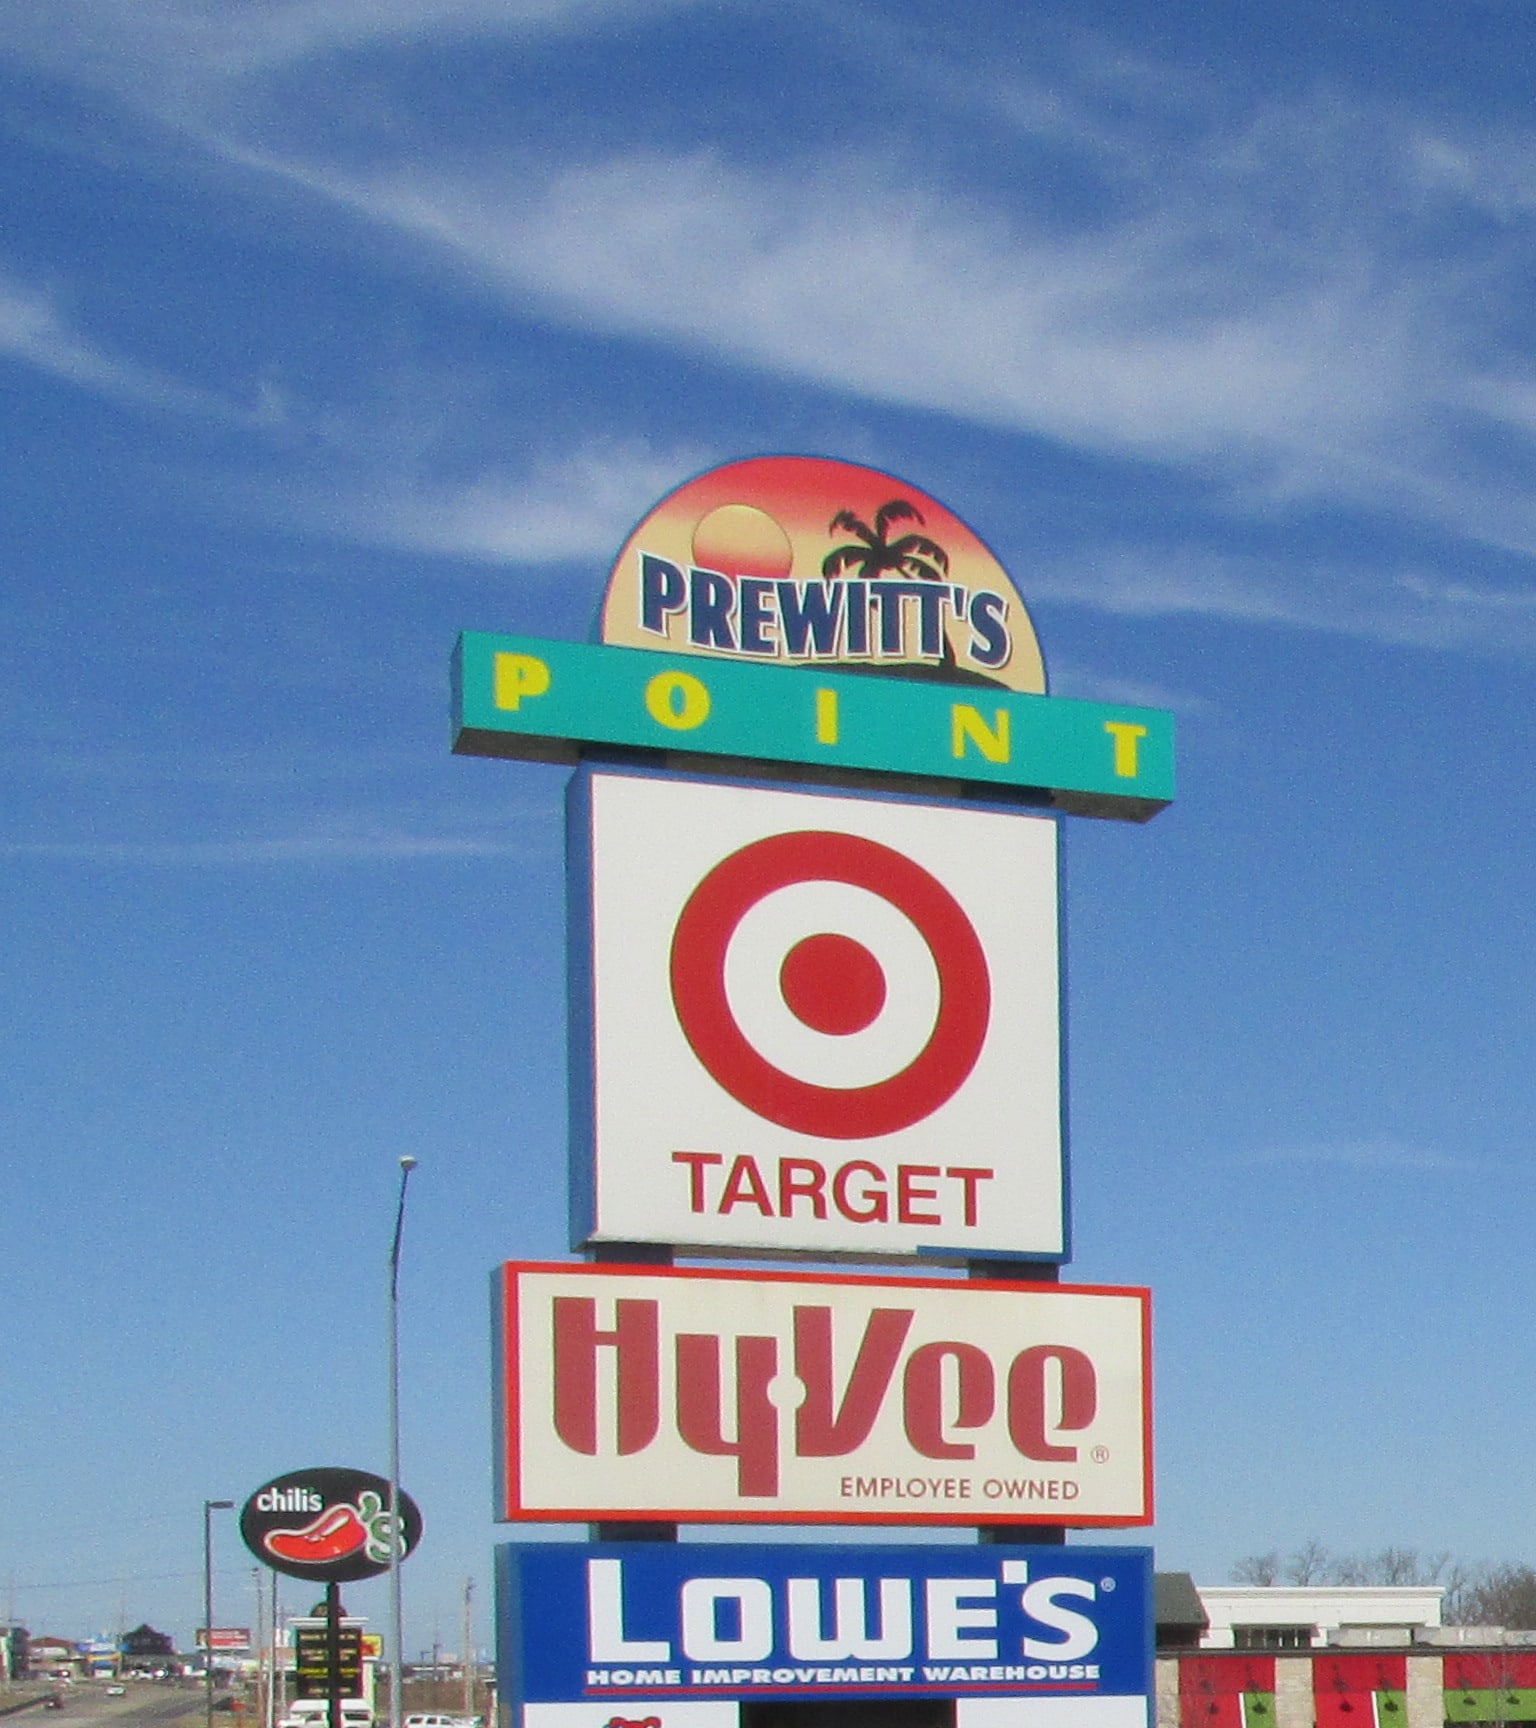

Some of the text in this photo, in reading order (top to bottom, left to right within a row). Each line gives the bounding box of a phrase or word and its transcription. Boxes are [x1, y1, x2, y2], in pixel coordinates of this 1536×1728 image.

[638, 549, 1012, 669] PREWITT'S
[494, 652, 1148, 778] POINT
[672, 1151, 994, 1227] TARGET
[840, 1476, 1080, 1501] EMPLOYEE OWNED
[588, 1559, 1099, 1663] LOWE'S
[587, 1664, 1100, 1686] HOME IMPROVEMENT WAREHOUSE
